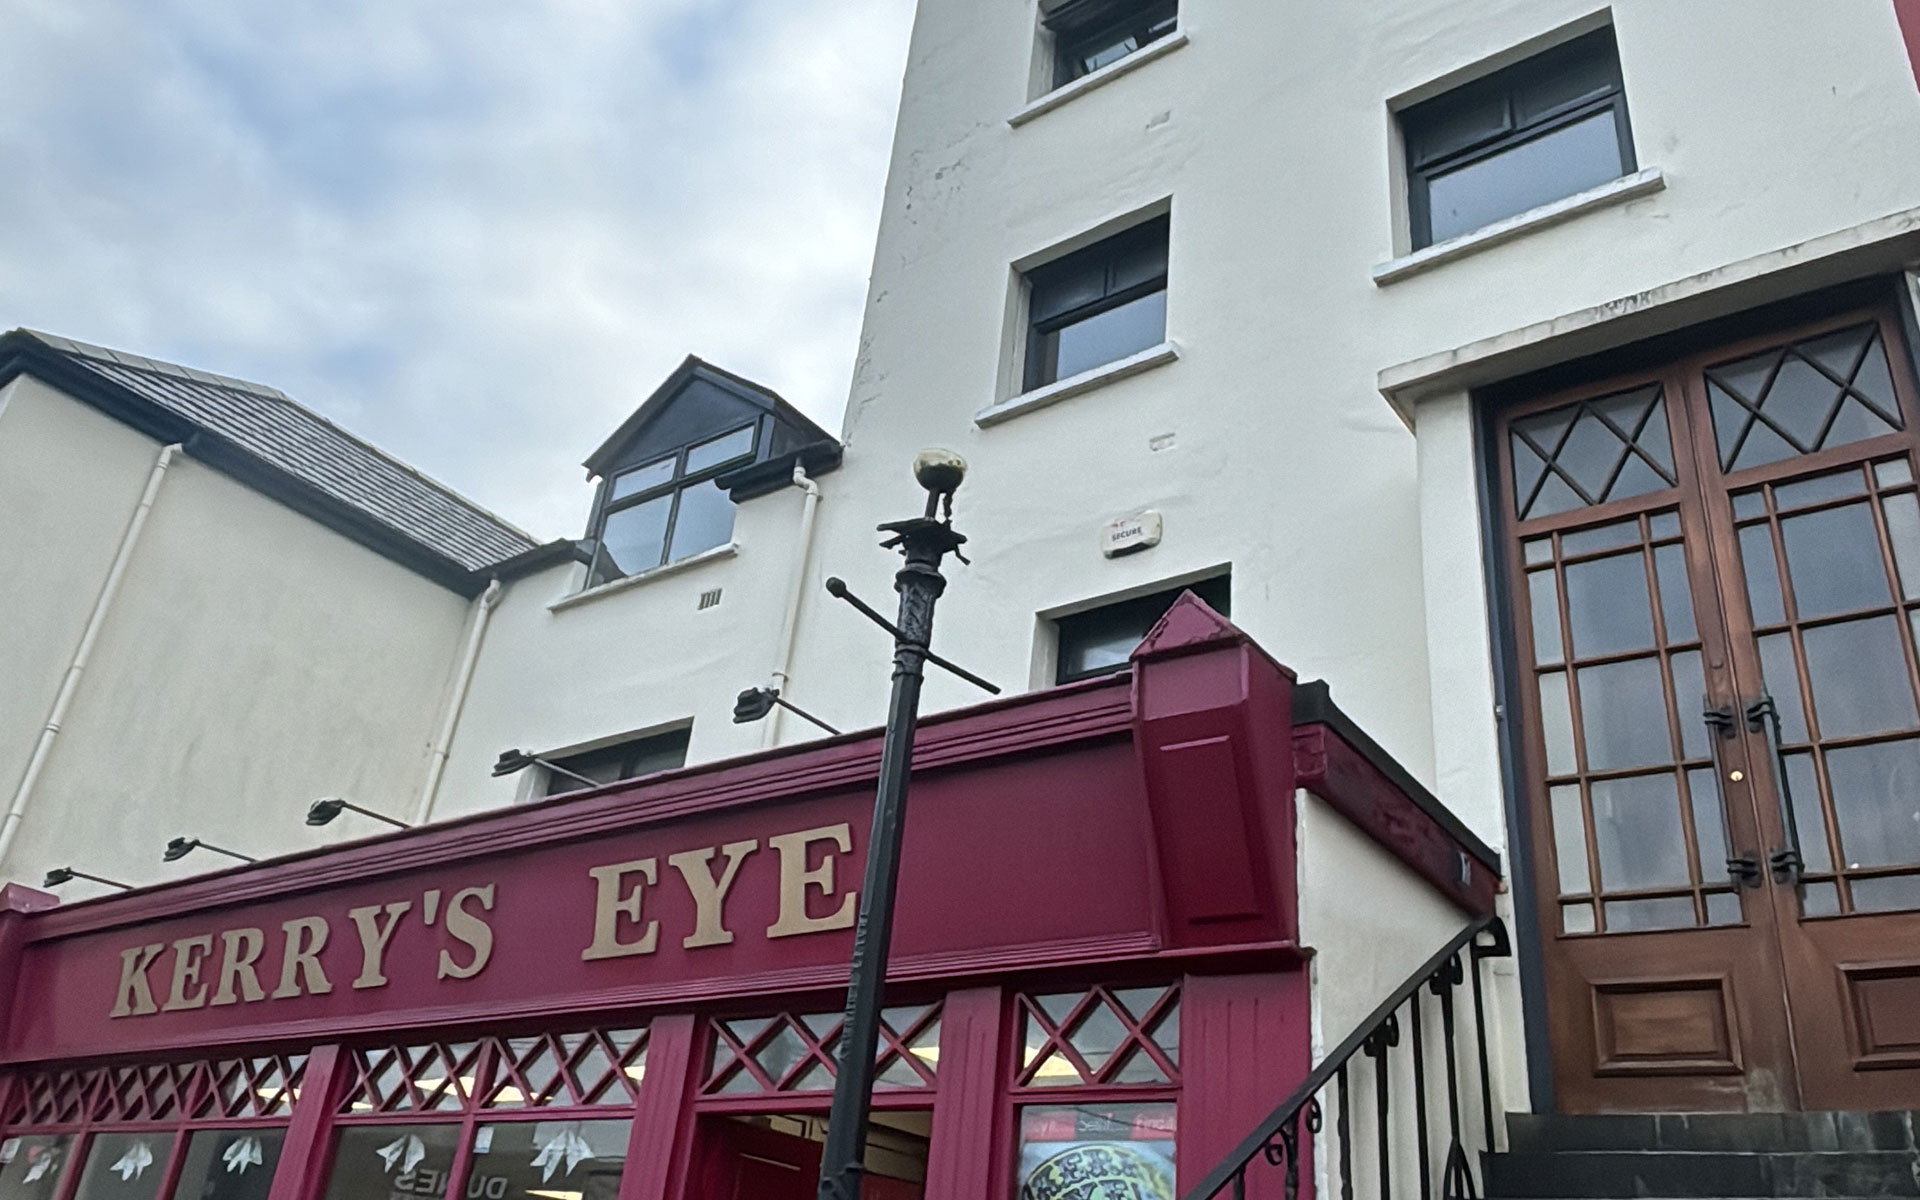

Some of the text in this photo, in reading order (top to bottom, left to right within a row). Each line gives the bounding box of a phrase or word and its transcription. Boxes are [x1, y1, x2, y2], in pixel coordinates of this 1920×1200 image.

[1112, 526, 1142, 542] SECURE
[110, 823, 858, 1018] KERRY'S EYE
